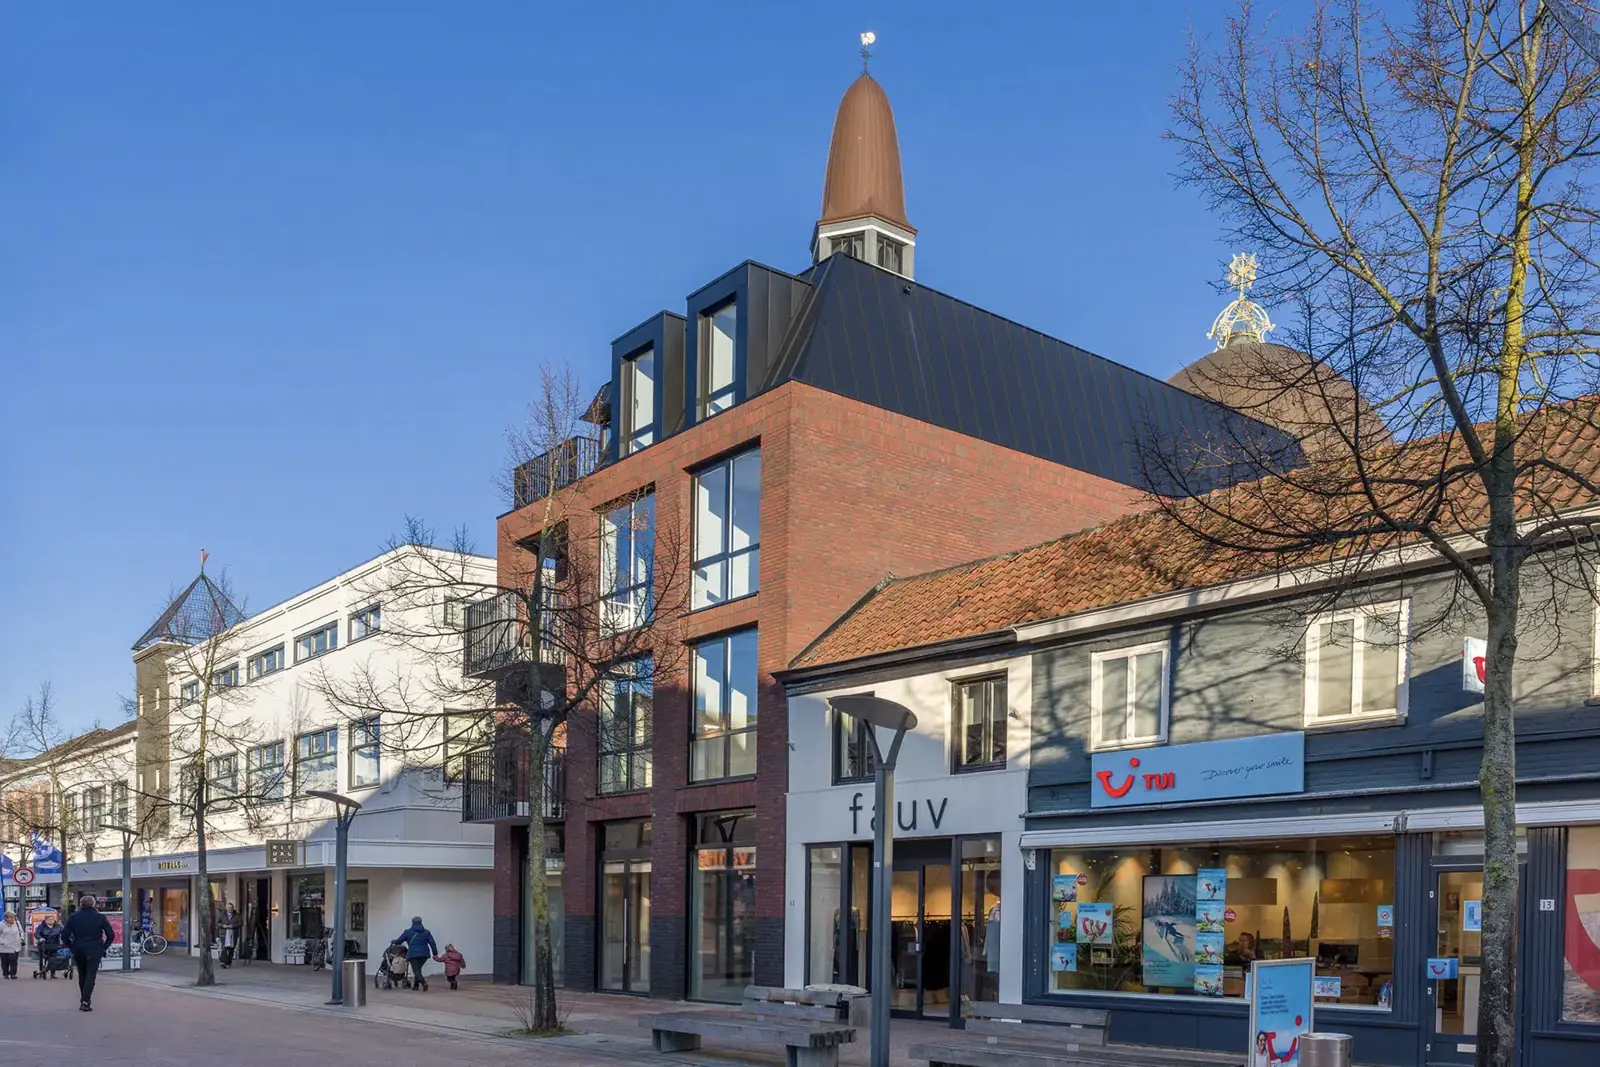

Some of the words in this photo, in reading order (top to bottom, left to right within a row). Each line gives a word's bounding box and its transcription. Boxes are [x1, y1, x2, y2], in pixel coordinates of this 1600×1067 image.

[1200, 769, 1244, 780] Discover
[1245, 764, 1265, 779] your
[1266, 757, 1294, 768] smile
[1142, 771, 1175, 791] TUI
[1542, 900, 1552, 909] 13
